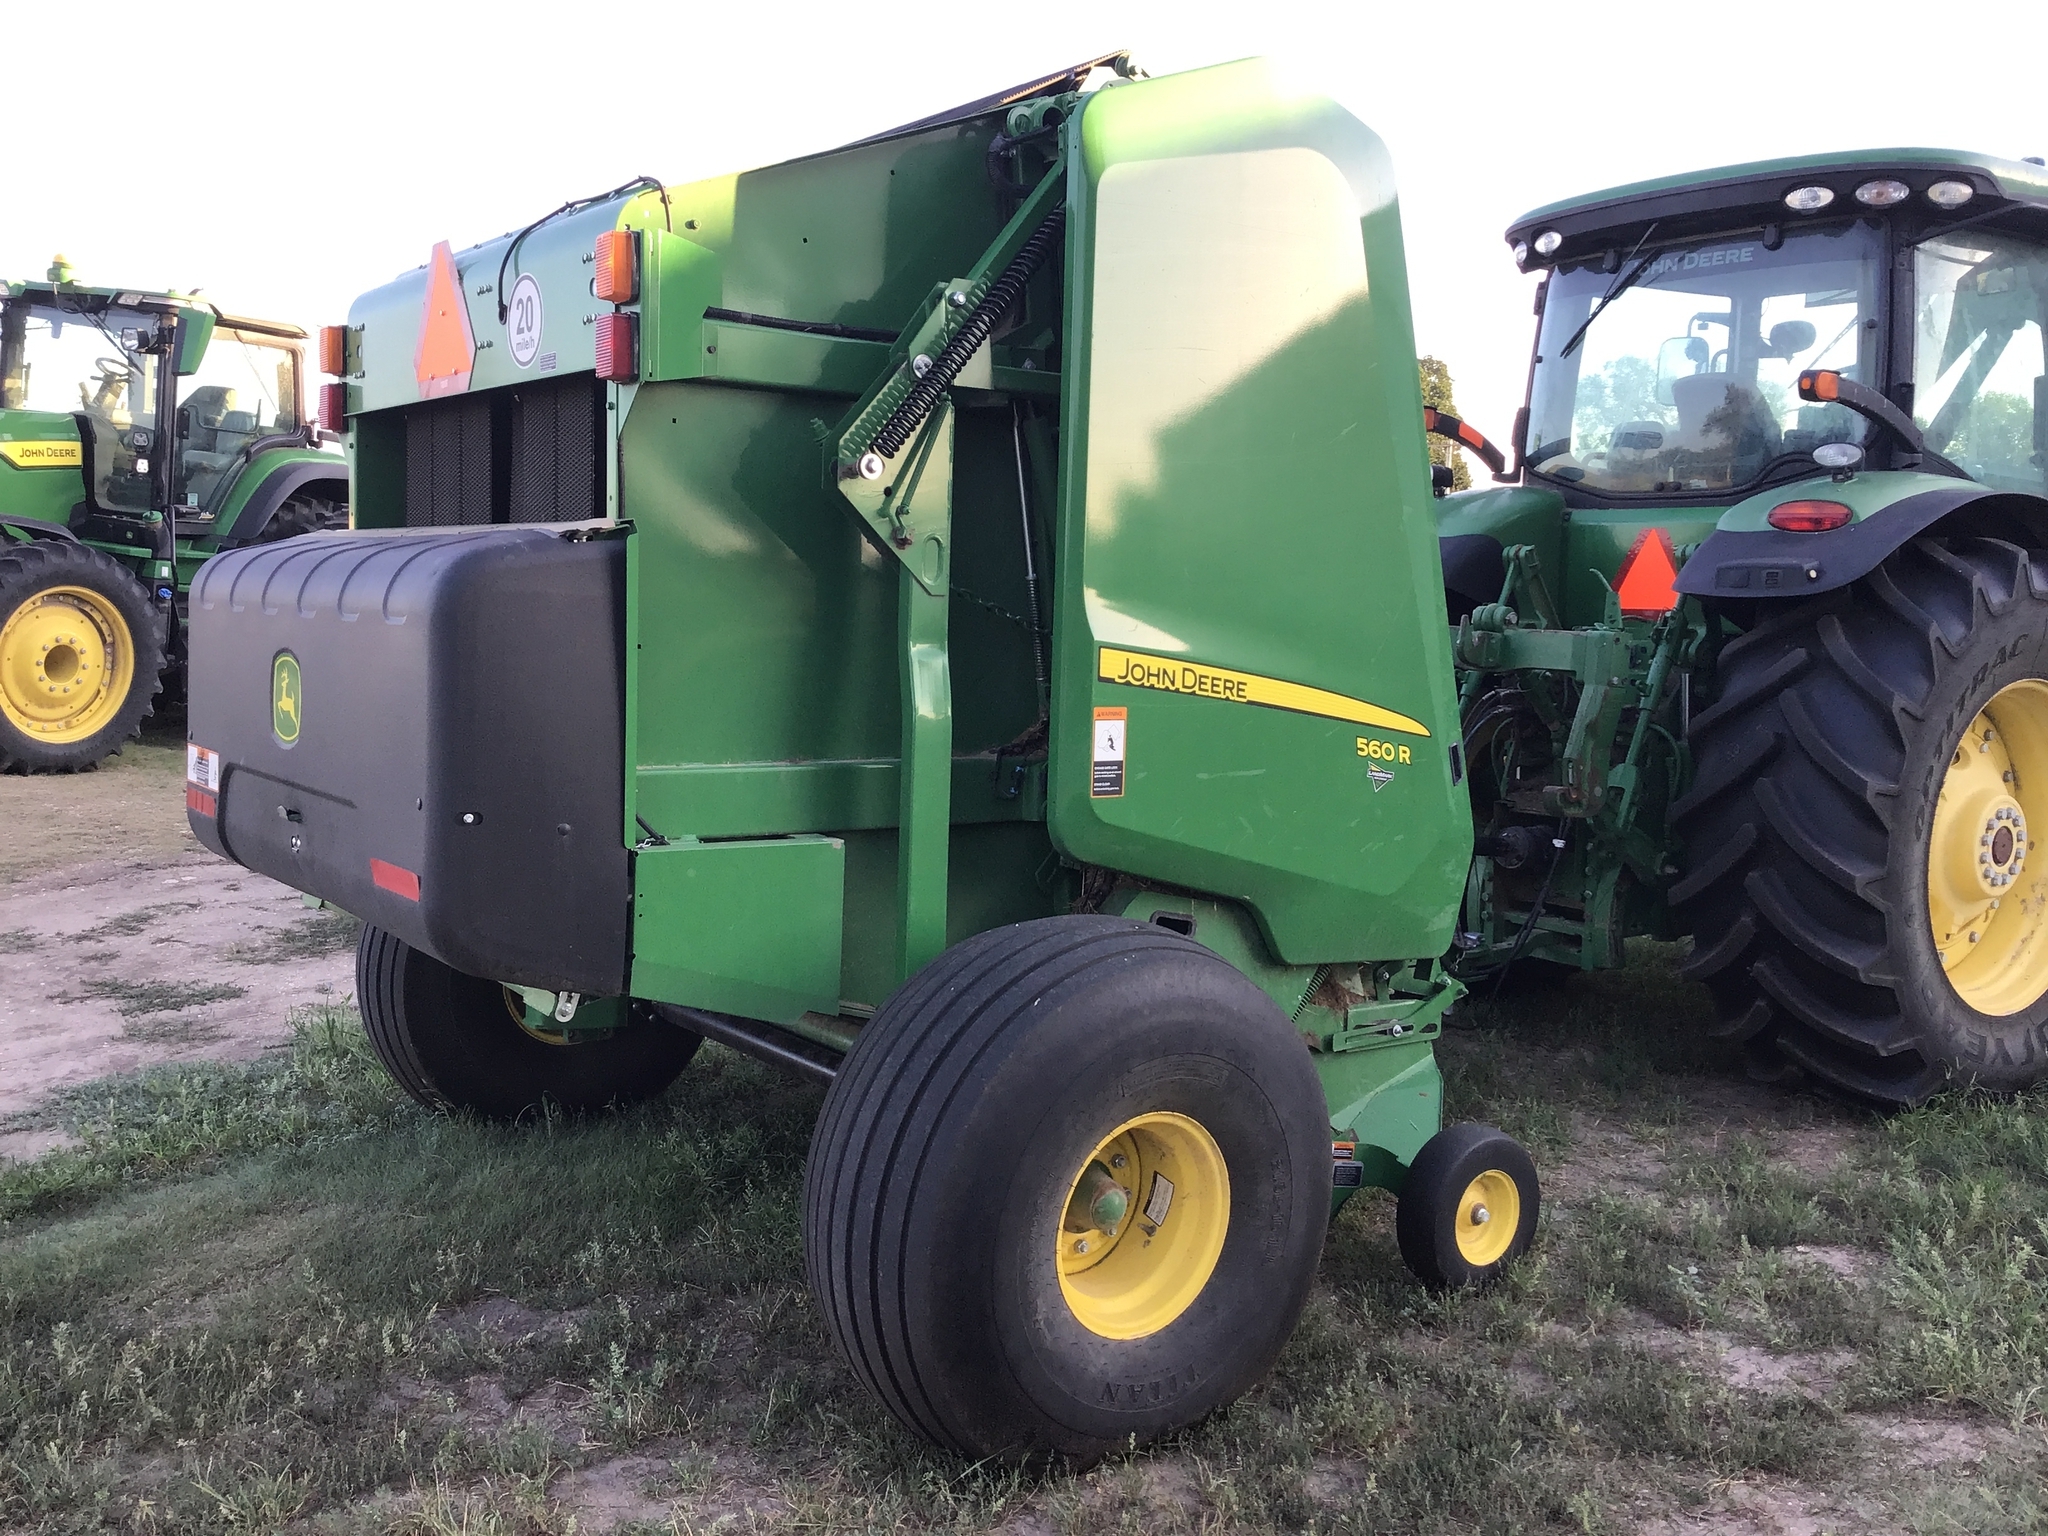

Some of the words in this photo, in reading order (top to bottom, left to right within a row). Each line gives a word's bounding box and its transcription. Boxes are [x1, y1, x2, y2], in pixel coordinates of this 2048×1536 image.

[1682, 246, 1755, 270] DEERE
[516, 294, 534, 336] 20
[515, 336, 535, 353] mile/h
[19, 447, 45, 458] JOHN
[46, 447, 77, 458] DEERE
[1116, 657, 1176, 688] JOHN
[1181, 666, 1248, 700] DEERE
[1355, 735, 1396, 763] 560
[1397, 743, 1413, 766] R
